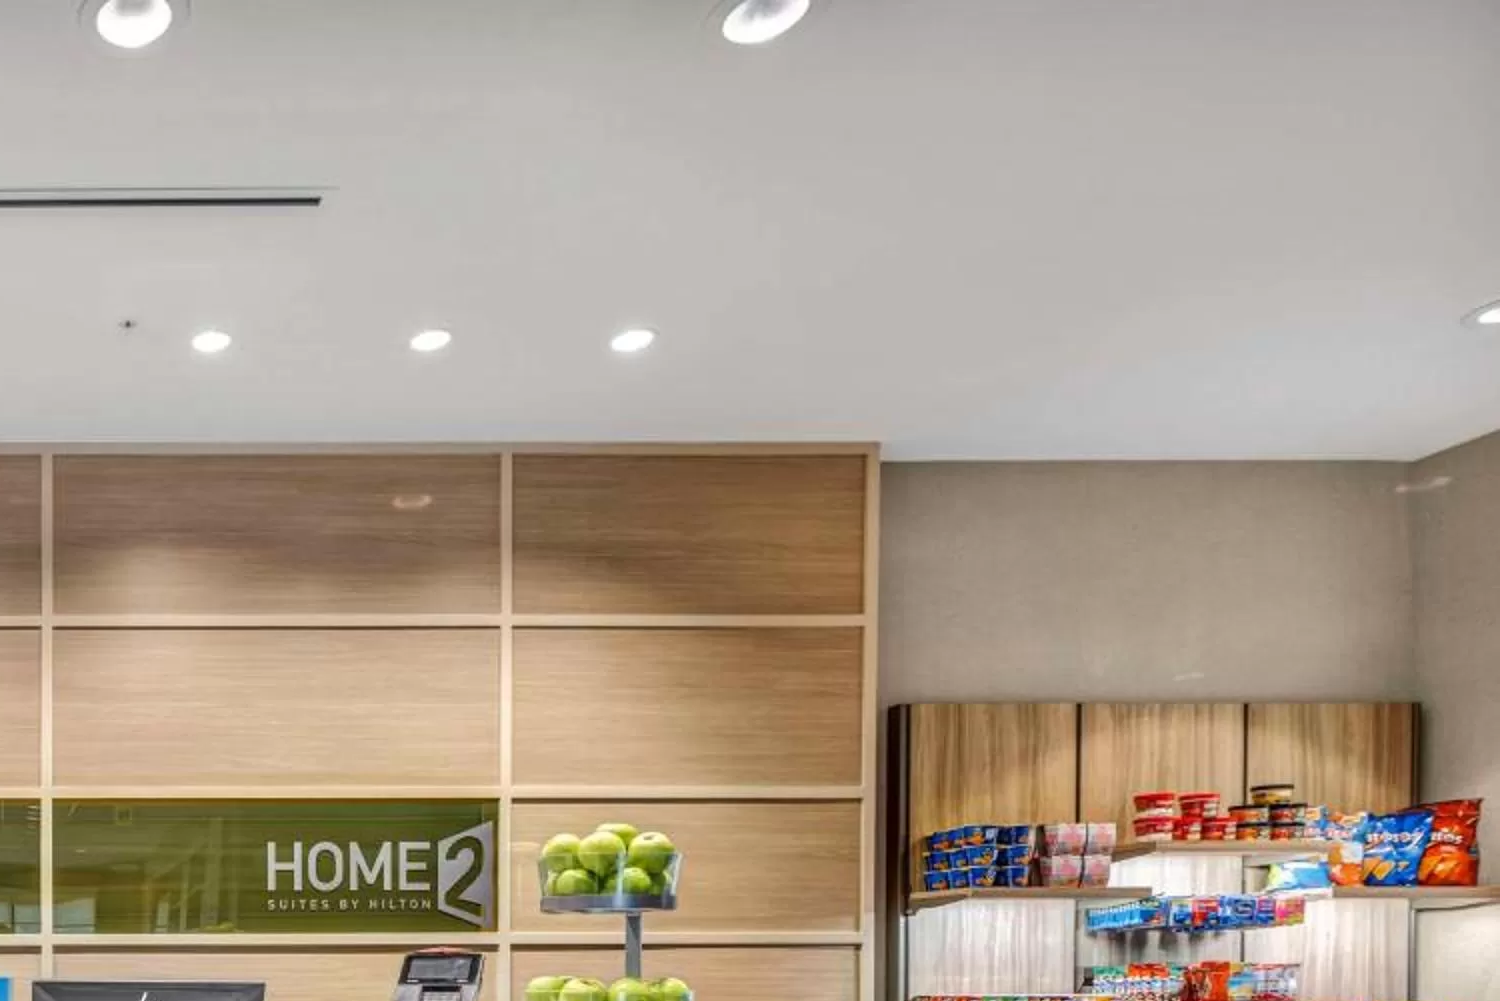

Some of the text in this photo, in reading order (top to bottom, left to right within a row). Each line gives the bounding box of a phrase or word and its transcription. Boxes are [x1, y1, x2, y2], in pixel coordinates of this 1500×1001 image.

[267, 898, 432, 911] SUITES BY HILTON
